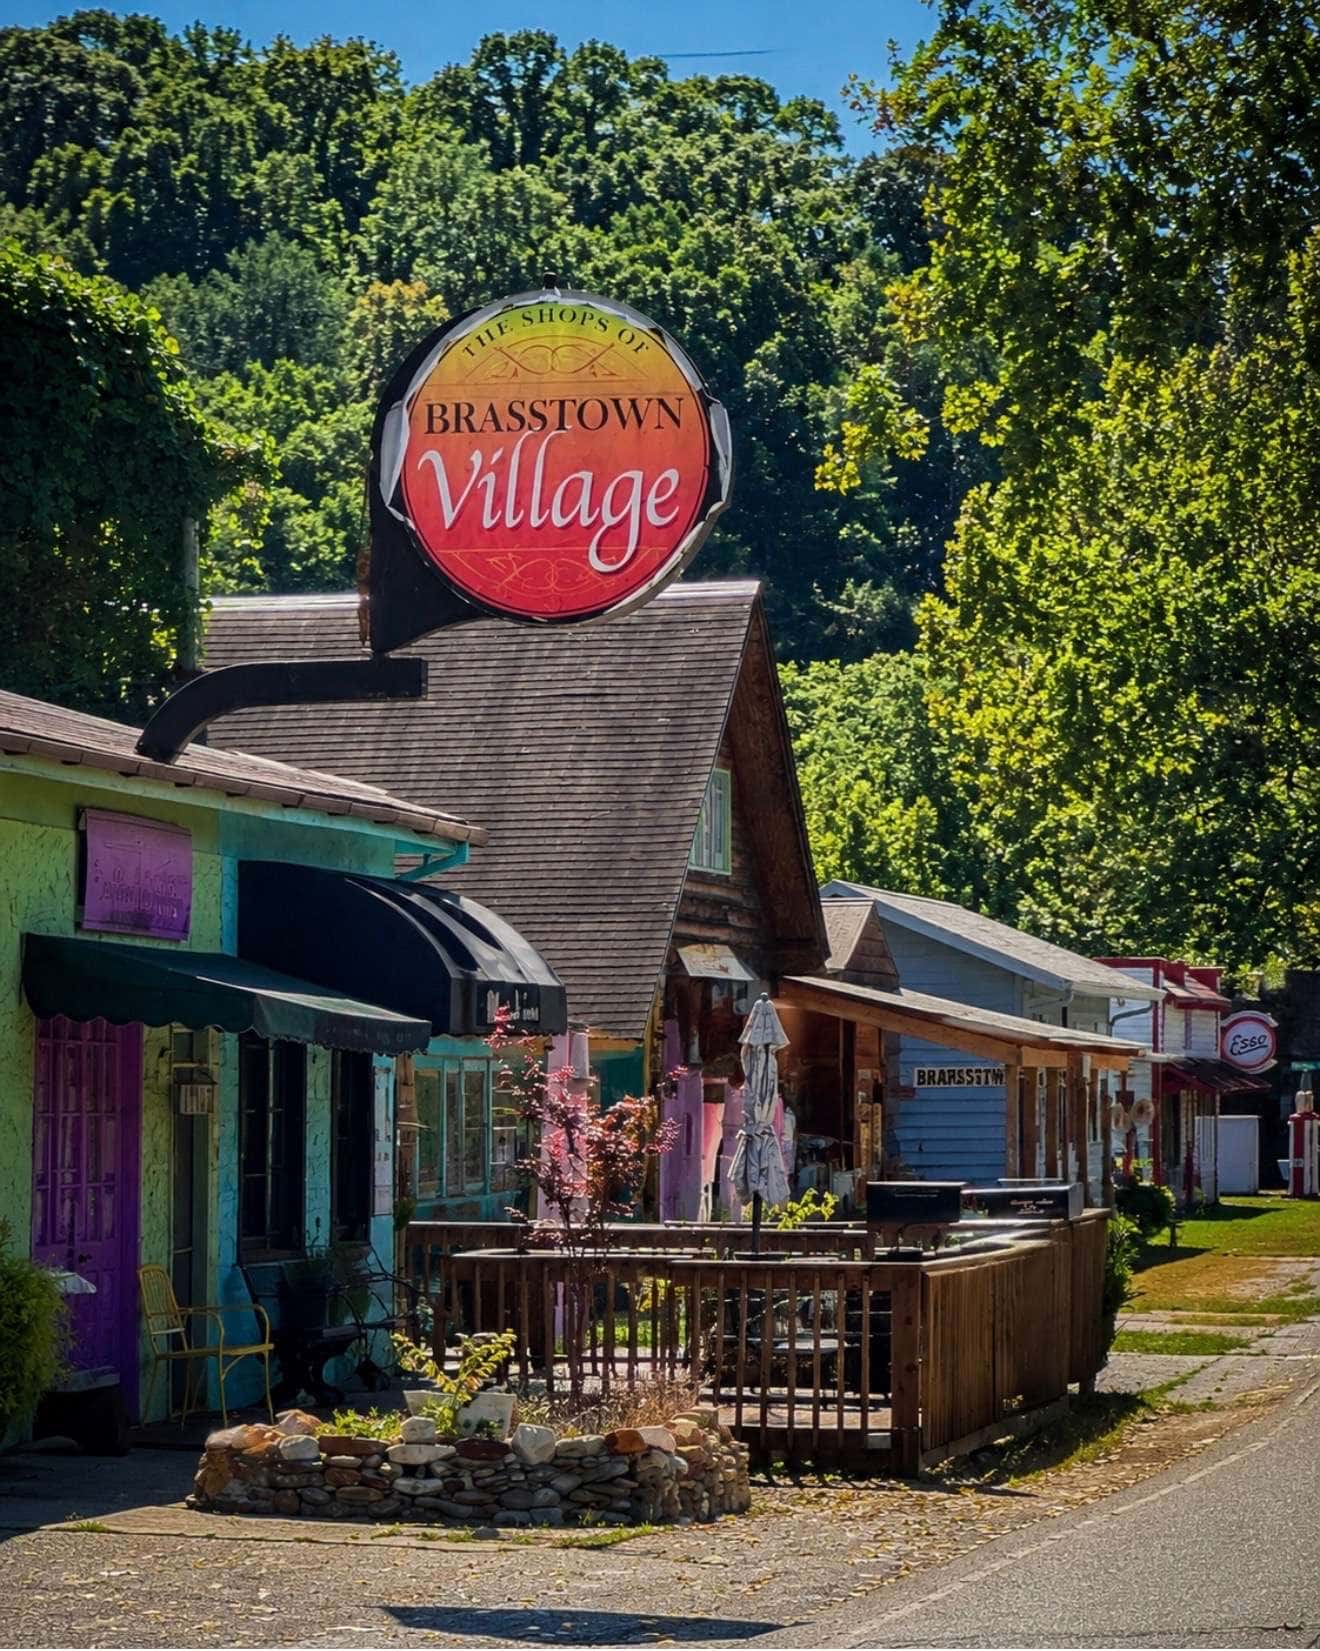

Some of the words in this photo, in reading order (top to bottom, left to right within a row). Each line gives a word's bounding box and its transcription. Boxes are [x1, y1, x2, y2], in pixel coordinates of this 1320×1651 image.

[462, 318, 514, 358] THE
[521, 307, 610, 333] SHOPS
[617, 327, 650, 354] OF
[423, 397, 684, 435] BRASSTOWN
[417, 426, 681, 573] Village
[1229, 1034, 1269, 1056] Esso
